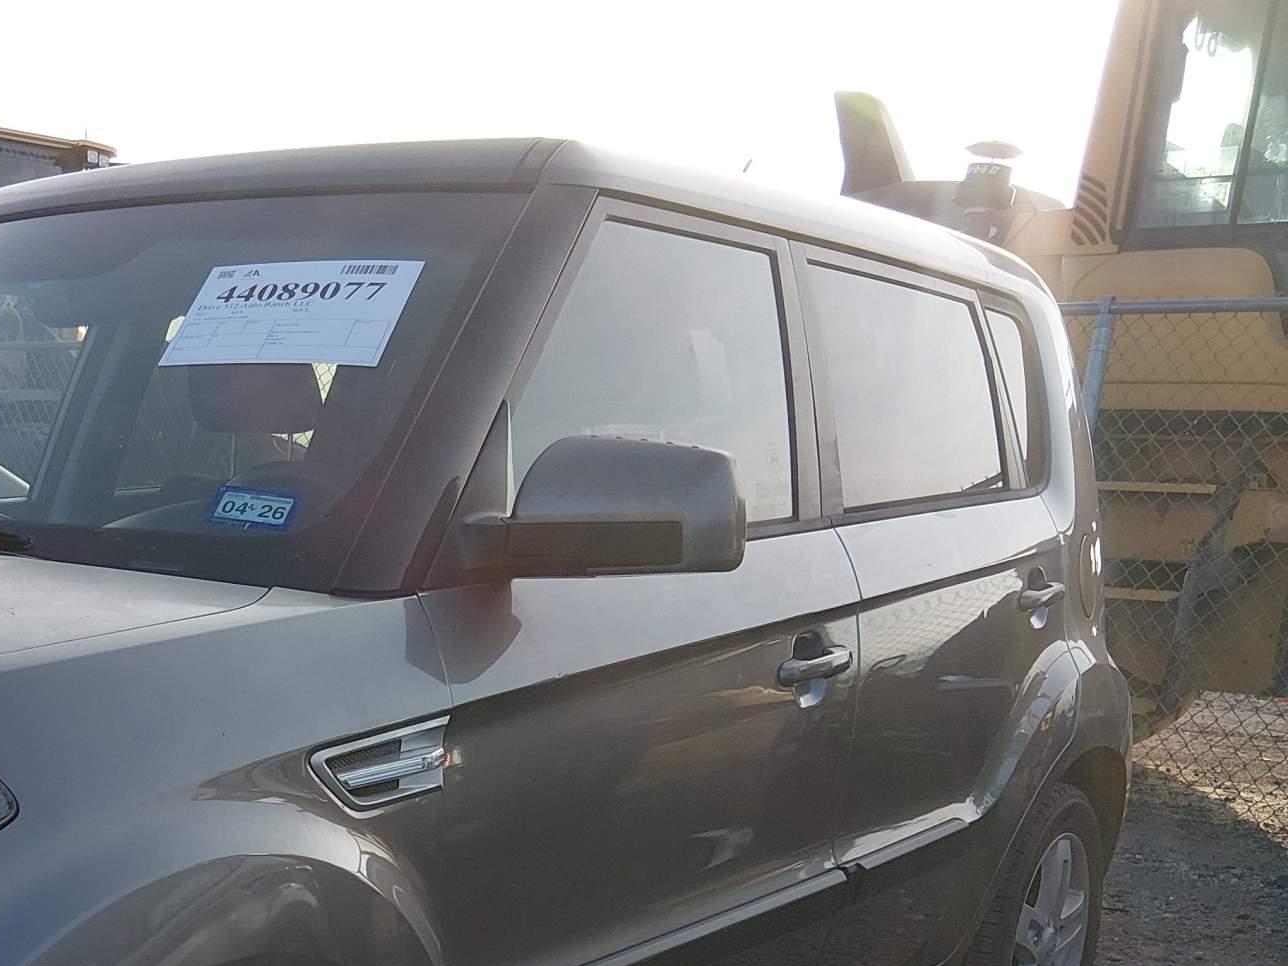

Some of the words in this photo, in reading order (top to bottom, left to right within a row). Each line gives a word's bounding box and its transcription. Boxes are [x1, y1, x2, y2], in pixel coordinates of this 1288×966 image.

[216, 281, 389, 303] 44089077
[221, 500, 249, 515] 04
[257, 504, 287, 520] 26
